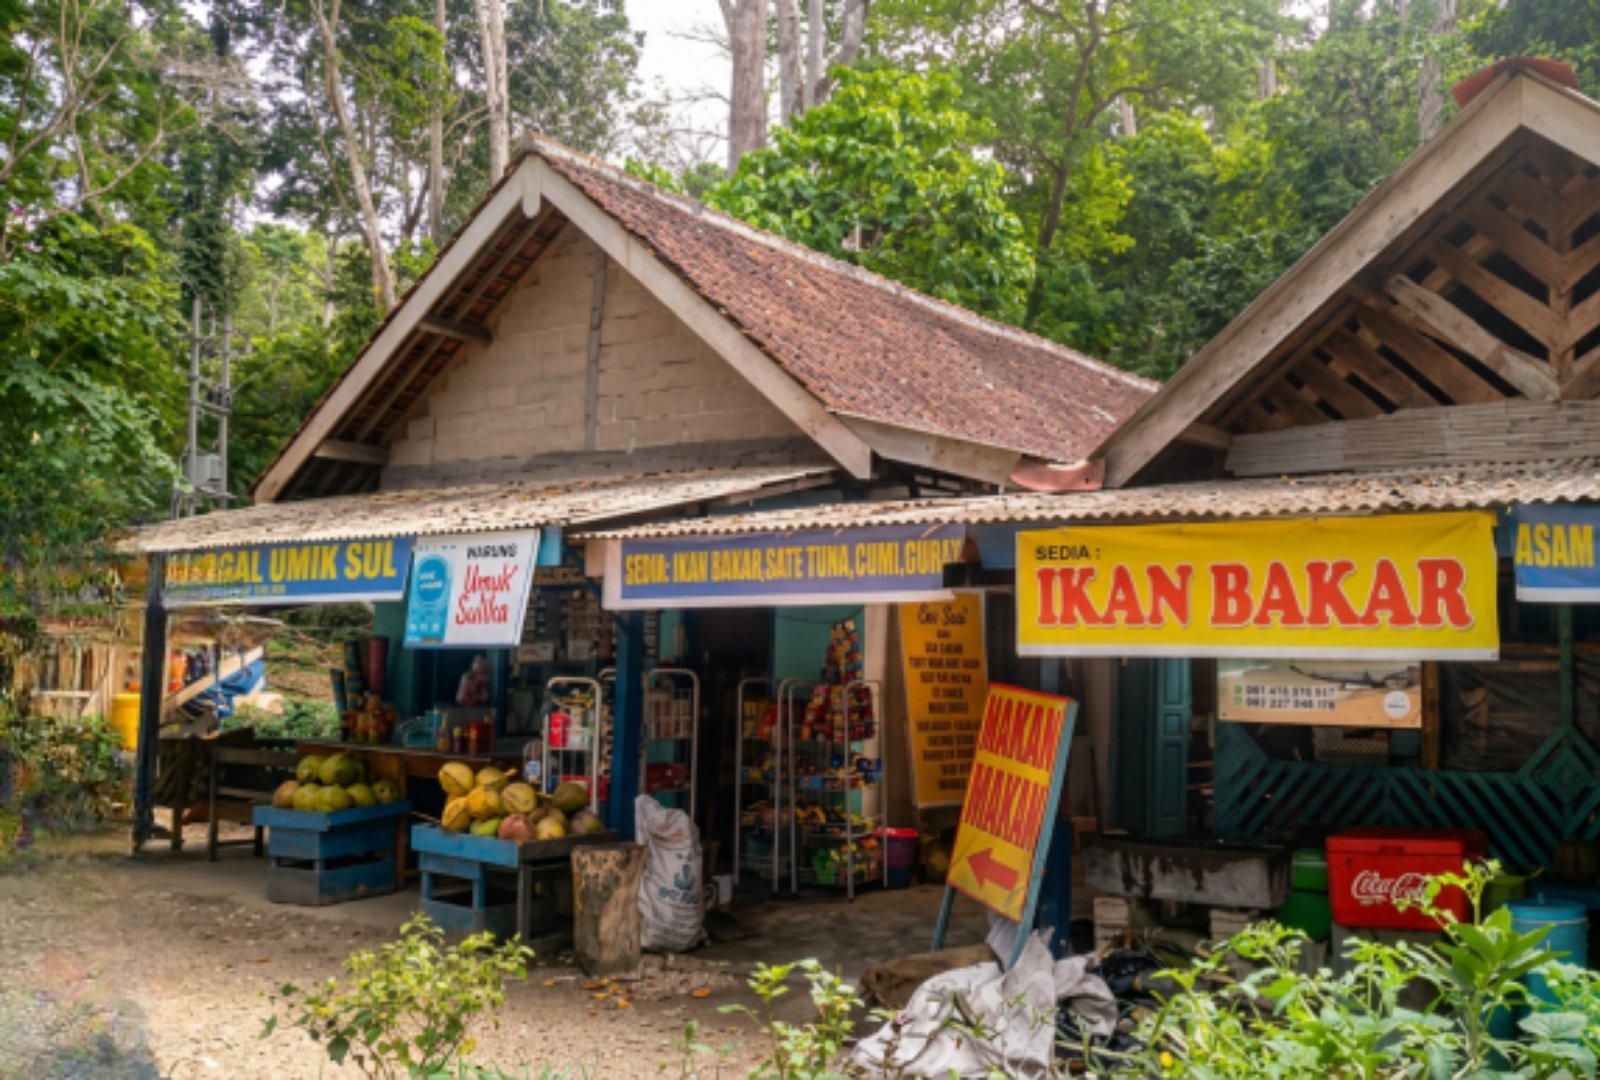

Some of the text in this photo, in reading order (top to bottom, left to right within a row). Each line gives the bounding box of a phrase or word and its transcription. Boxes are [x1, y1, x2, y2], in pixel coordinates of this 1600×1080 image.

[270, 545, 340, 582] UMIK
[344, 540, 397, 580] SUL
[467, 543, 518, 559] WARUNG
[672, 550, 708, 583] IKAN
[1515, 522, 1594, 568] ASAM
[1036, 557, 1474, 629] IKAN BAKAR
[979, 694, 1062, 772] MAKAN
[966, 762, 1048, 853] MAKAN
